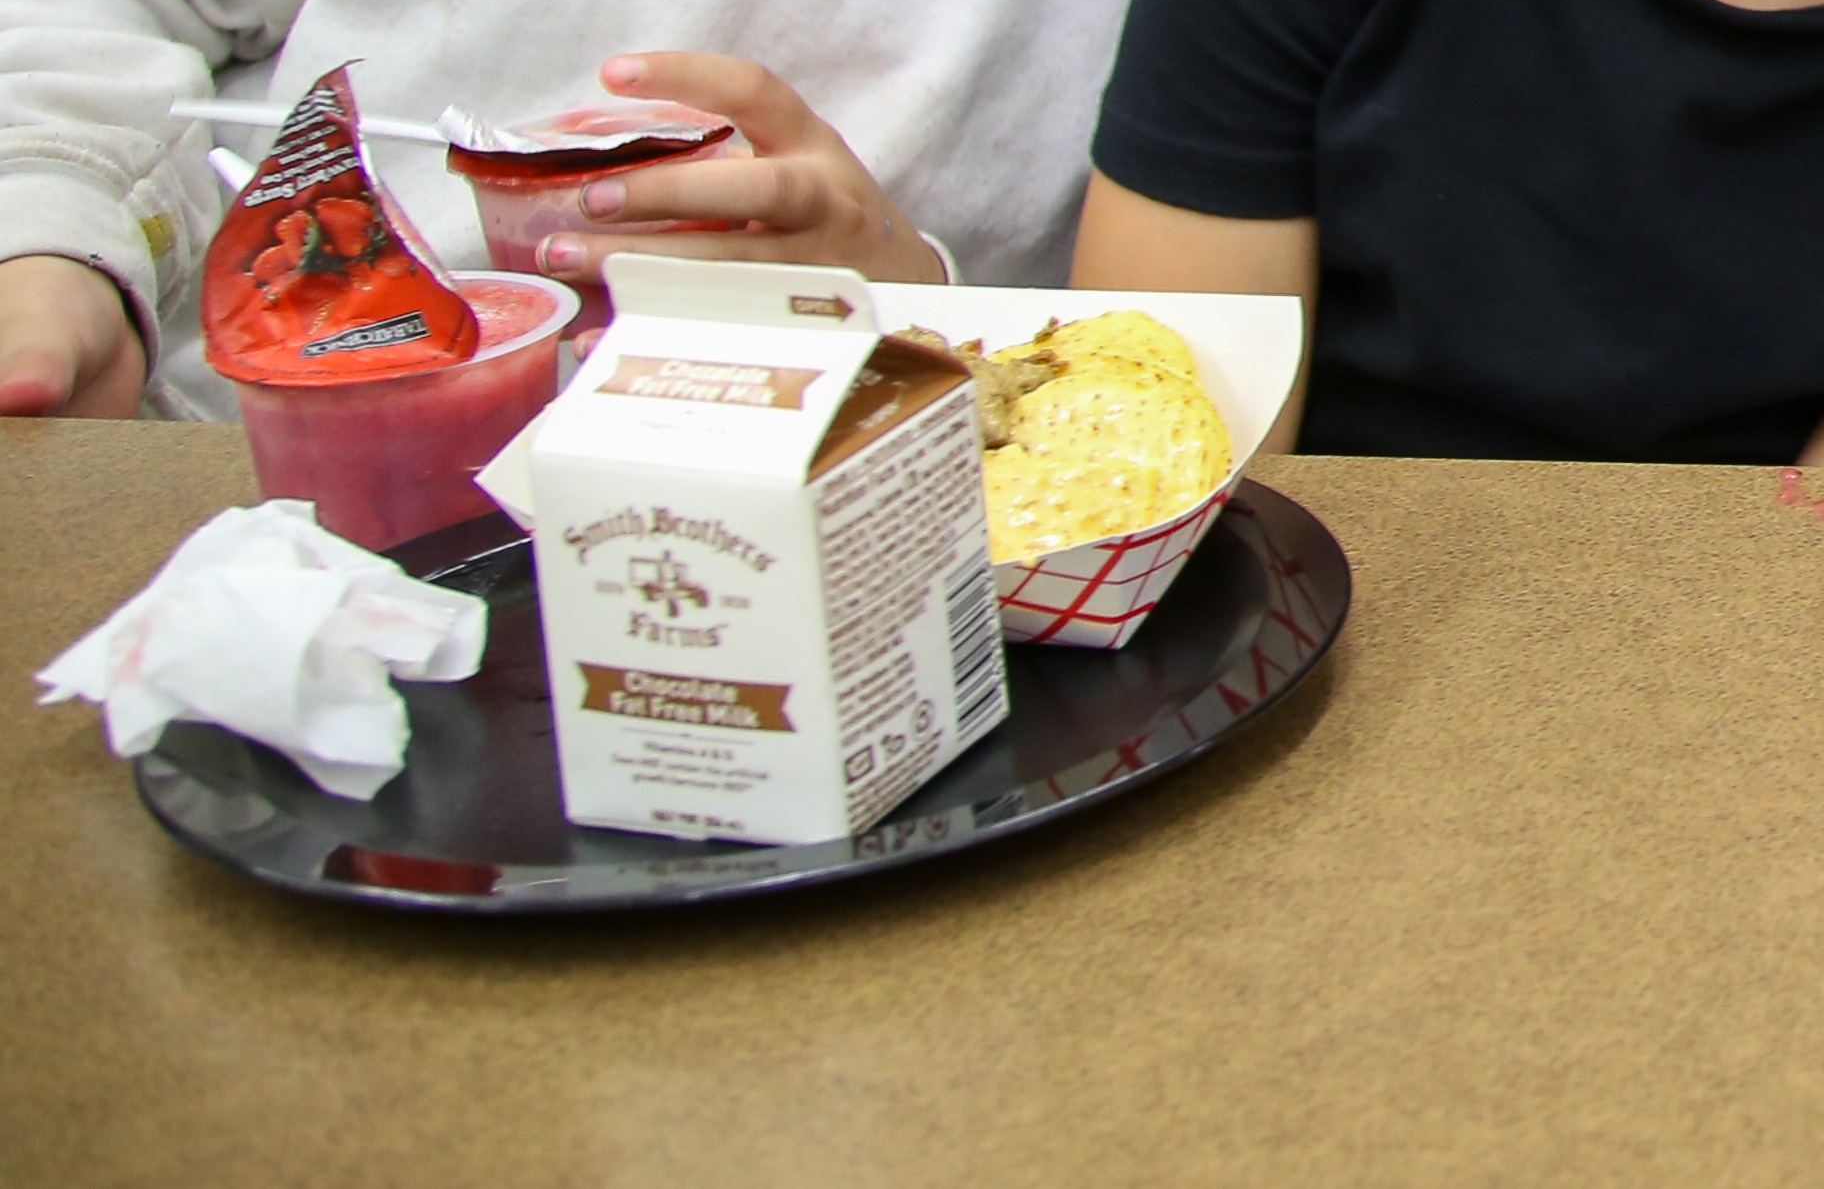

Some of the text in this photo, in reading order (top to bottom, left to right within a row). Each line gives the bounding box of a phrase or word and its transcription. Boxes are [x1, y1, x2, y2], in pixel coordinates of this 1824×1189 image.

[659, 360, 774, 387] Chocolate
[564, 506, 776, 572] Smith Brothers
[627, 611, 724, 647] Farms
[624, 671, 739, 704] Chocolate
[608, 690, 760, 728] Fat Free Milk
